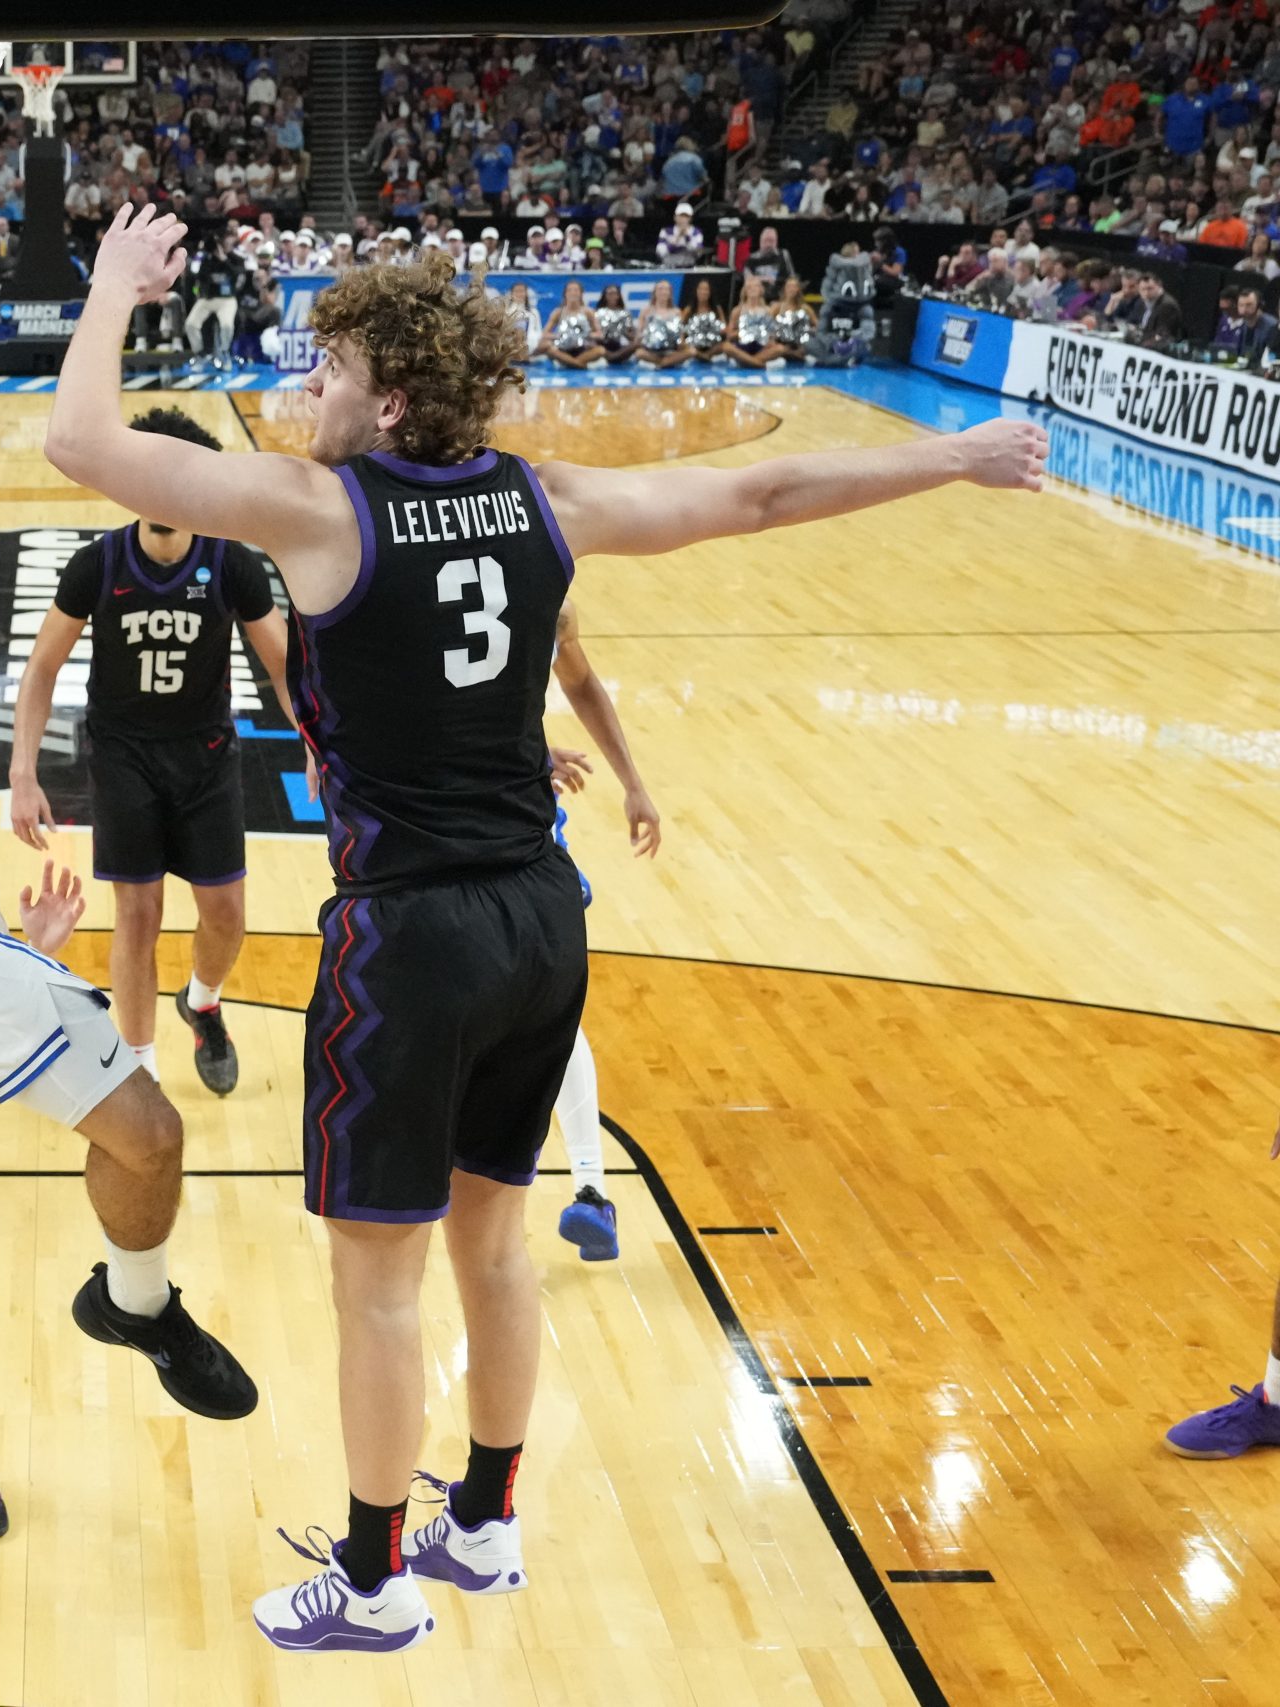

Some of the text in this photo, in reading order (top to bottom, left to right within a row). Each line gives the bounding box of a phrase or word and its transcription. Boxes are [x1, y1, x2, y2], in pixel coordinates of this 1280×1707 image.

[12, 304, 62, 320] MARCH
[17, 319, 78, 336] MADNES
[1047, 337, 1104, 410] FIRST
[1116, 357, 1219, 446] SECOND
[387, 489, 530, 545] LELEVICIUS
[121, 609, 202, 645] TCU
[435, 555, 512, 689] 3
[137, 650, 187, 694] 15
